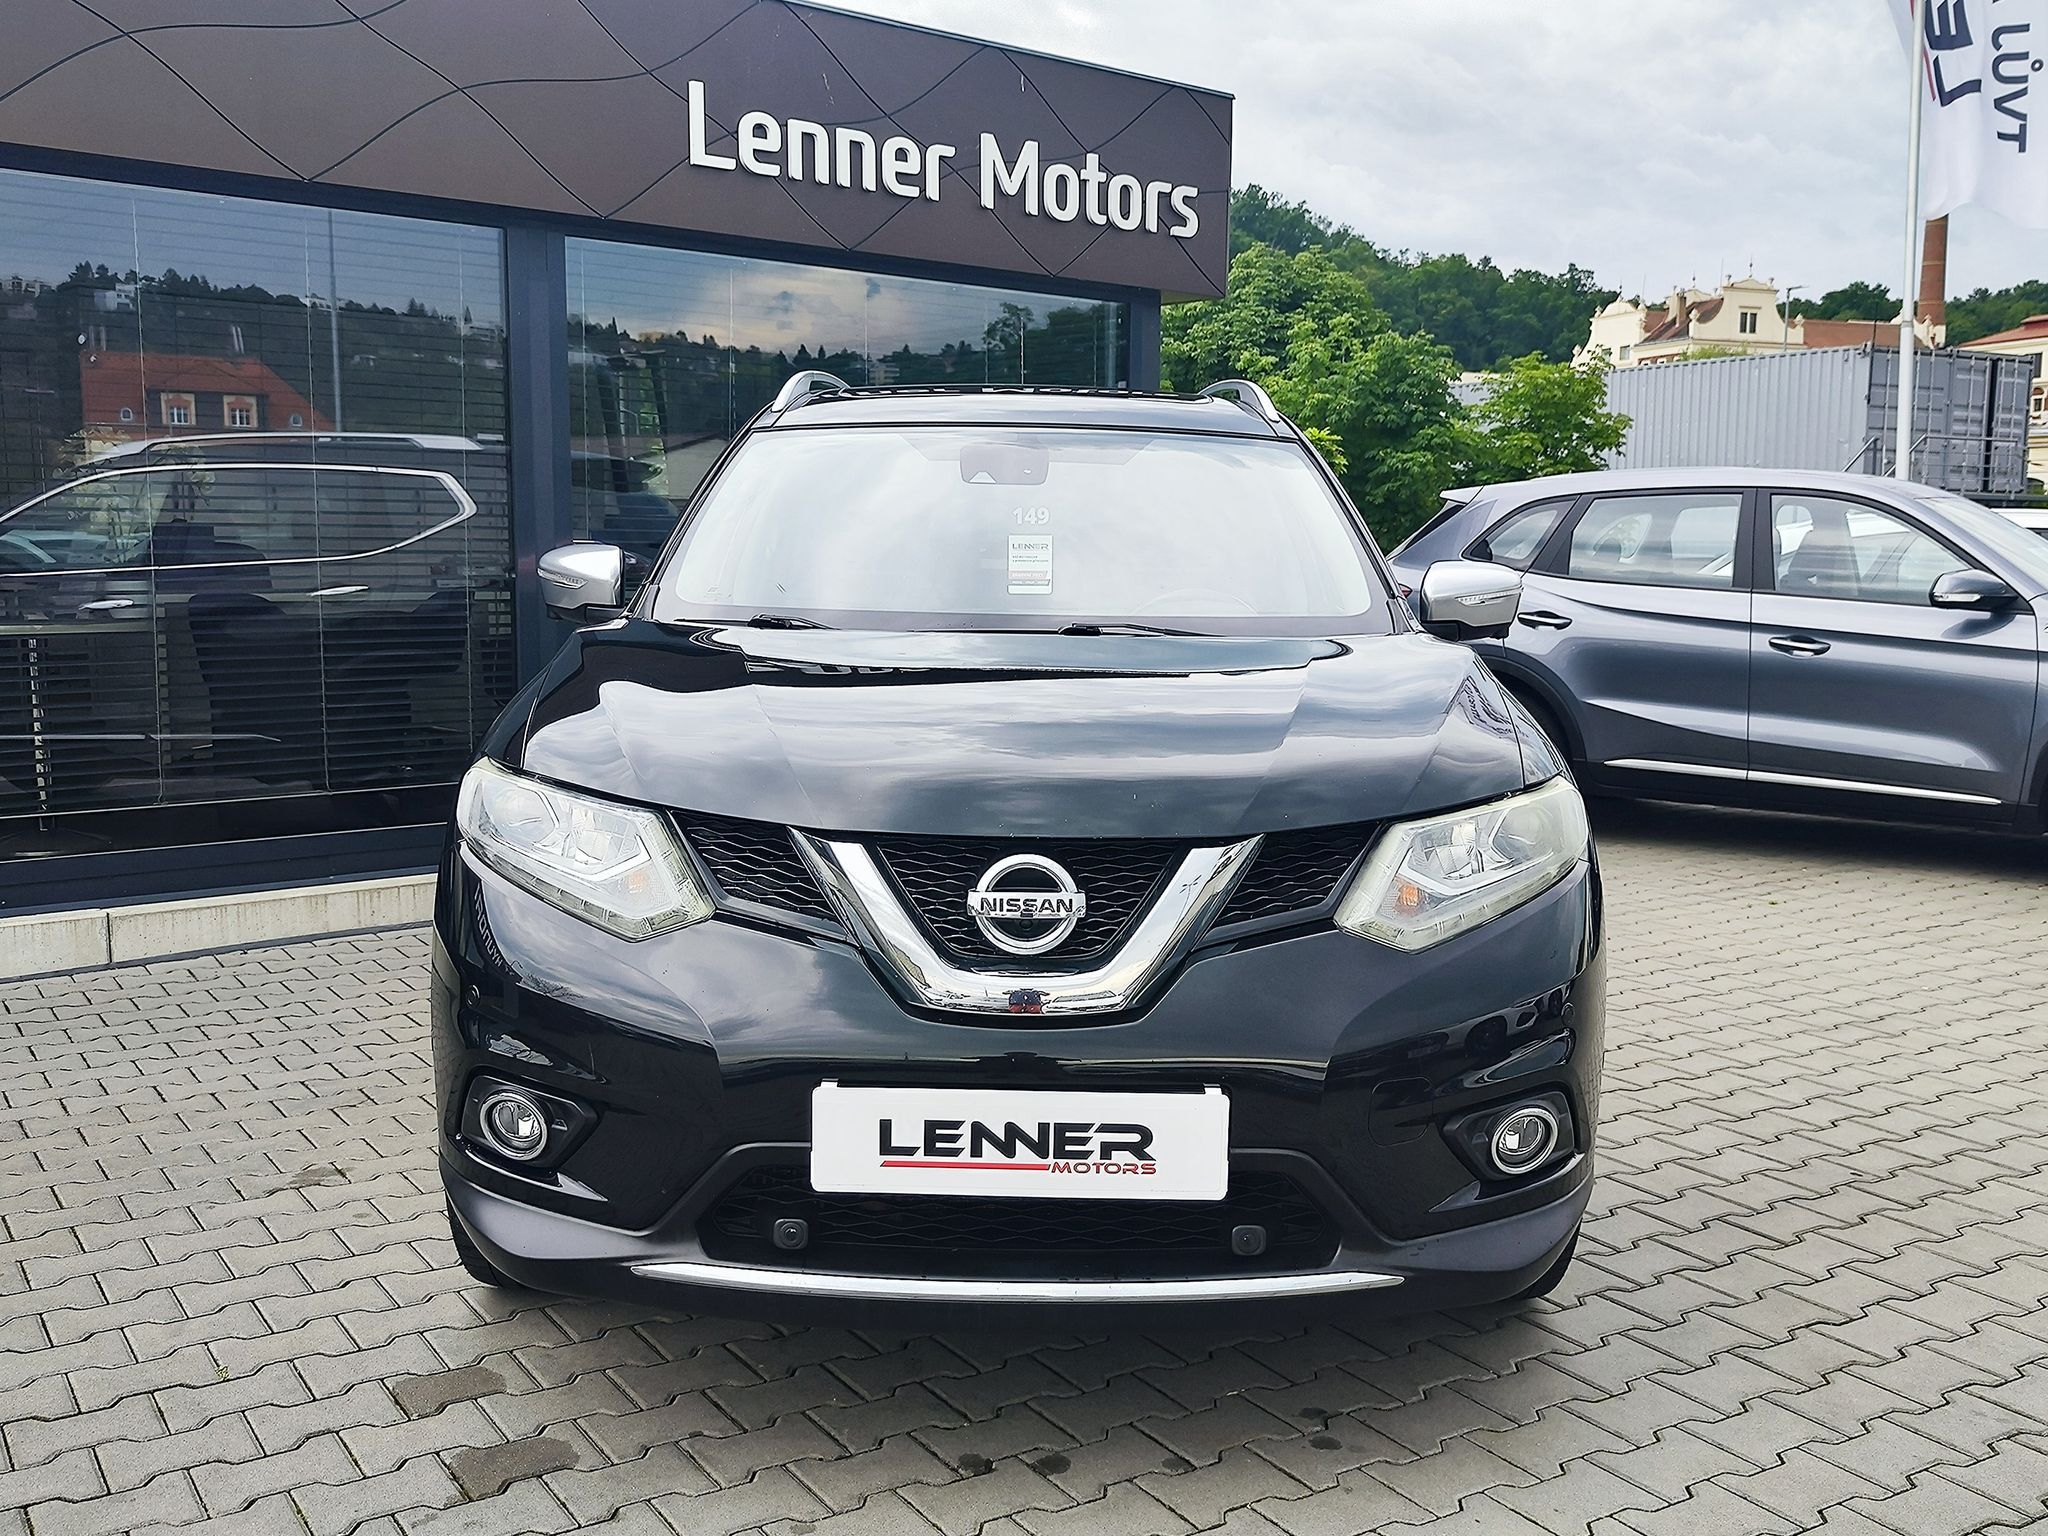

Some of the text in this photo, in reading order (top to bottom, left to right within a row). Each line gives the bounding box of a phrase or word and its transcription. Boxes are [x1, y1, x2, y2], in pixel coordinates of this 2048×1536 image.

[688, 80, 1199, 238] Lenner Motors
[1012, 506, 1050, 525] 149
[980, 897, 1073, 913] NISSAN
[879, 1118, 1156, 1161] LENNER
[1050, 1161, 1157, 1175] MOTORS
